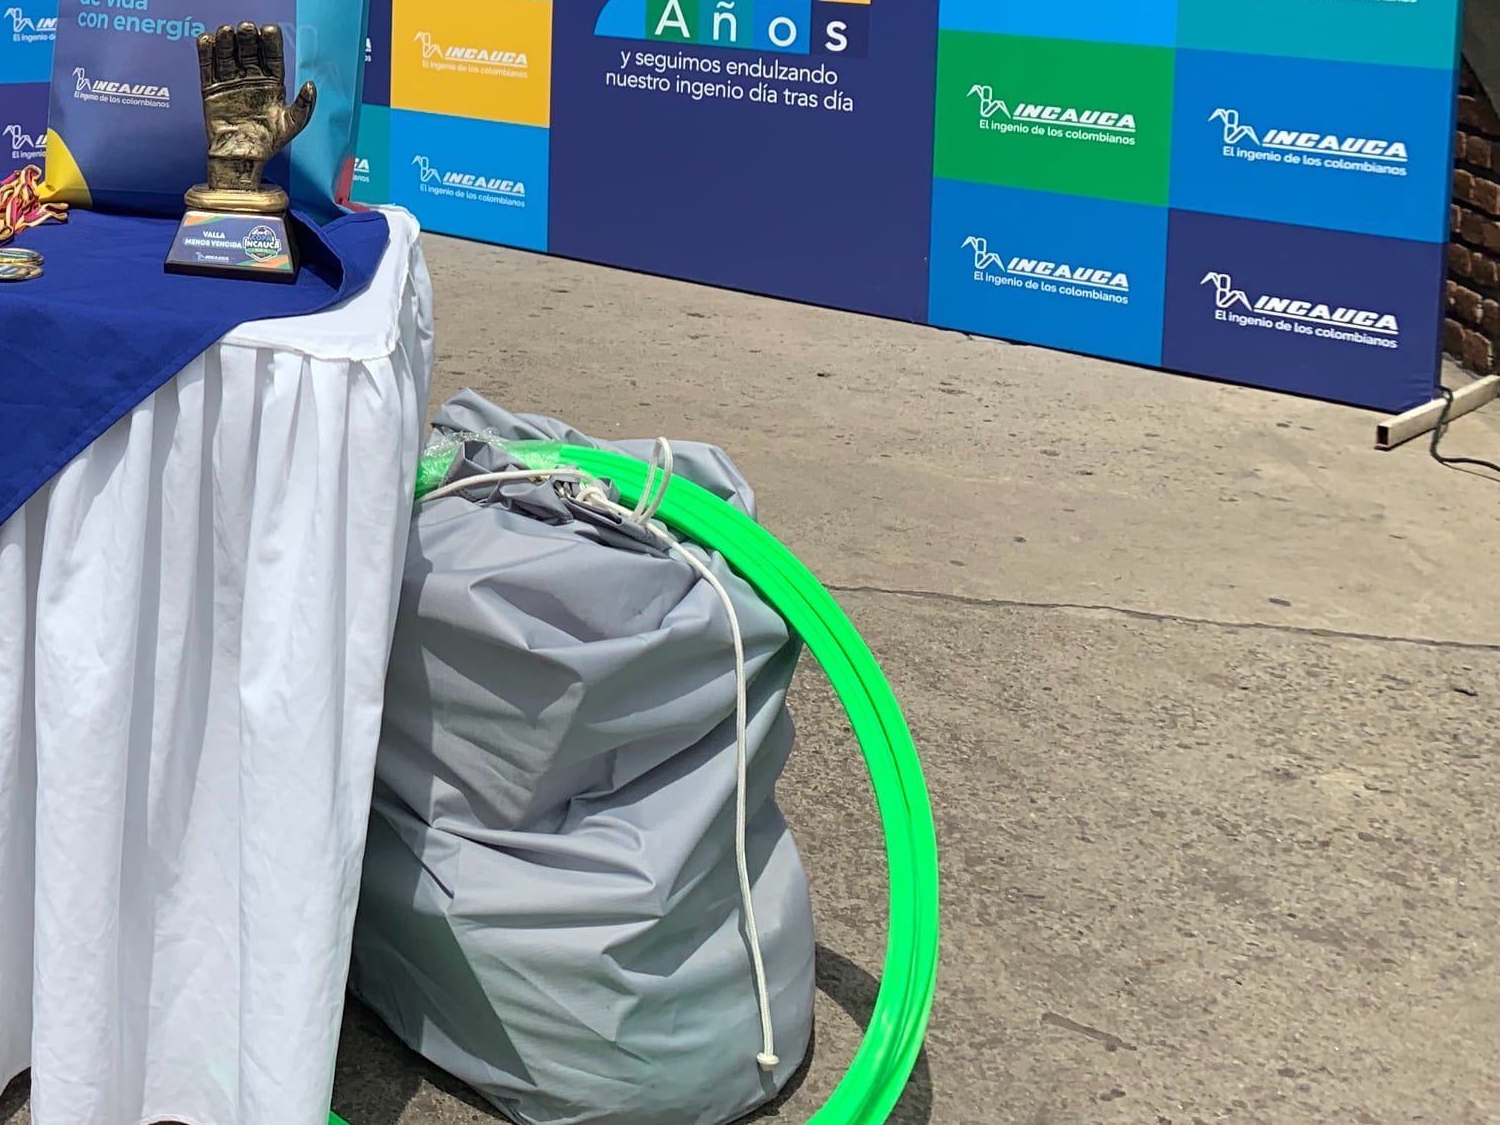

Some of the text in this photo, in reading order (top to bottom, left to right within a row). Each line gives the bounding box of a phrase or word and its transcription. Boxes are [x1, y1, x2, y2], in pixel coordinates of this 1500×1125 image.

[77, 11, 108, 29] con
[113, 12, 205, 42] energía
[446, 47, 527, 65] INCAUCA
[620, 51, 838, 85] y seguimos endulzando
[92, 80, 171, 97] INCAUCA
[605, 72, 854, 112] nuestro ingenio día tras día
[100, 95, 108, 103] de
[110, 96, 121, 105] los
[122, 98, 170, 109] colombianos
[1014, 104, 1135, 128] INCAUCA
[1263, 130, 1407, 157] INCAUCA
[1223, 146, 1406, 175] El ingenio de los colombianos
[443, 172, 524, 194] INCAUCA
[184, 238, 242, 249] MENOS VENCIDA
[202, 231, 226, 239] VALLA
[243, 239, 280, 248] INCAUCA
[1008, 258, 1128, 287] INCAUCA
[1254, 296, 1398, 330] INCAUCA
[1216, 310, 1397, 348] El ingenio de los colombianos
